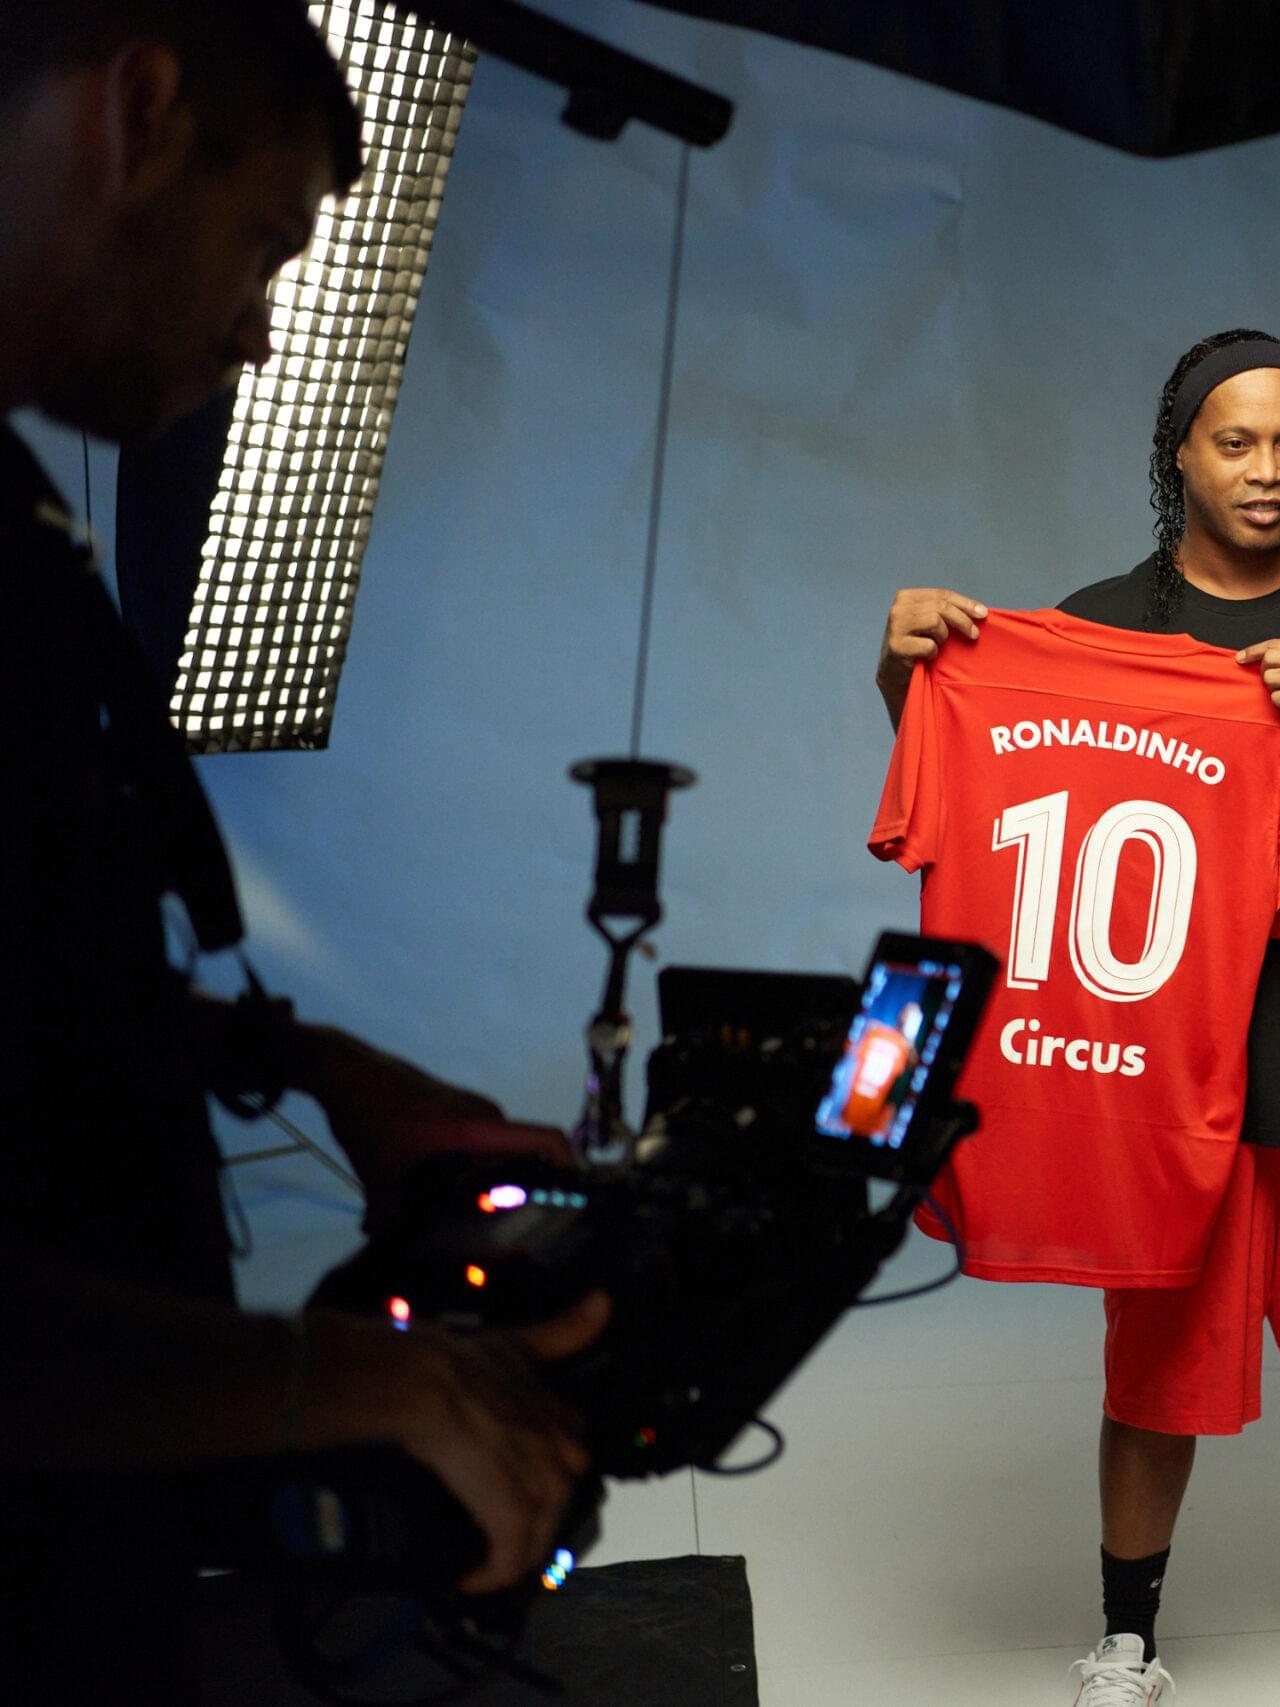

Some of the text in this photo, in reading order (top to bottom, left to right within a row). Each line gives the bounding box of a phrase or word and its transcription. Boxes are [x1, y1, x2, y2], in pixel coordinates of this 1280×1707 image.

[990, 719, 1225, 785] RONALDINHO
[991, 790, 1198, 1003] 10
[1000, 1018, 1146, 1077] Circus
